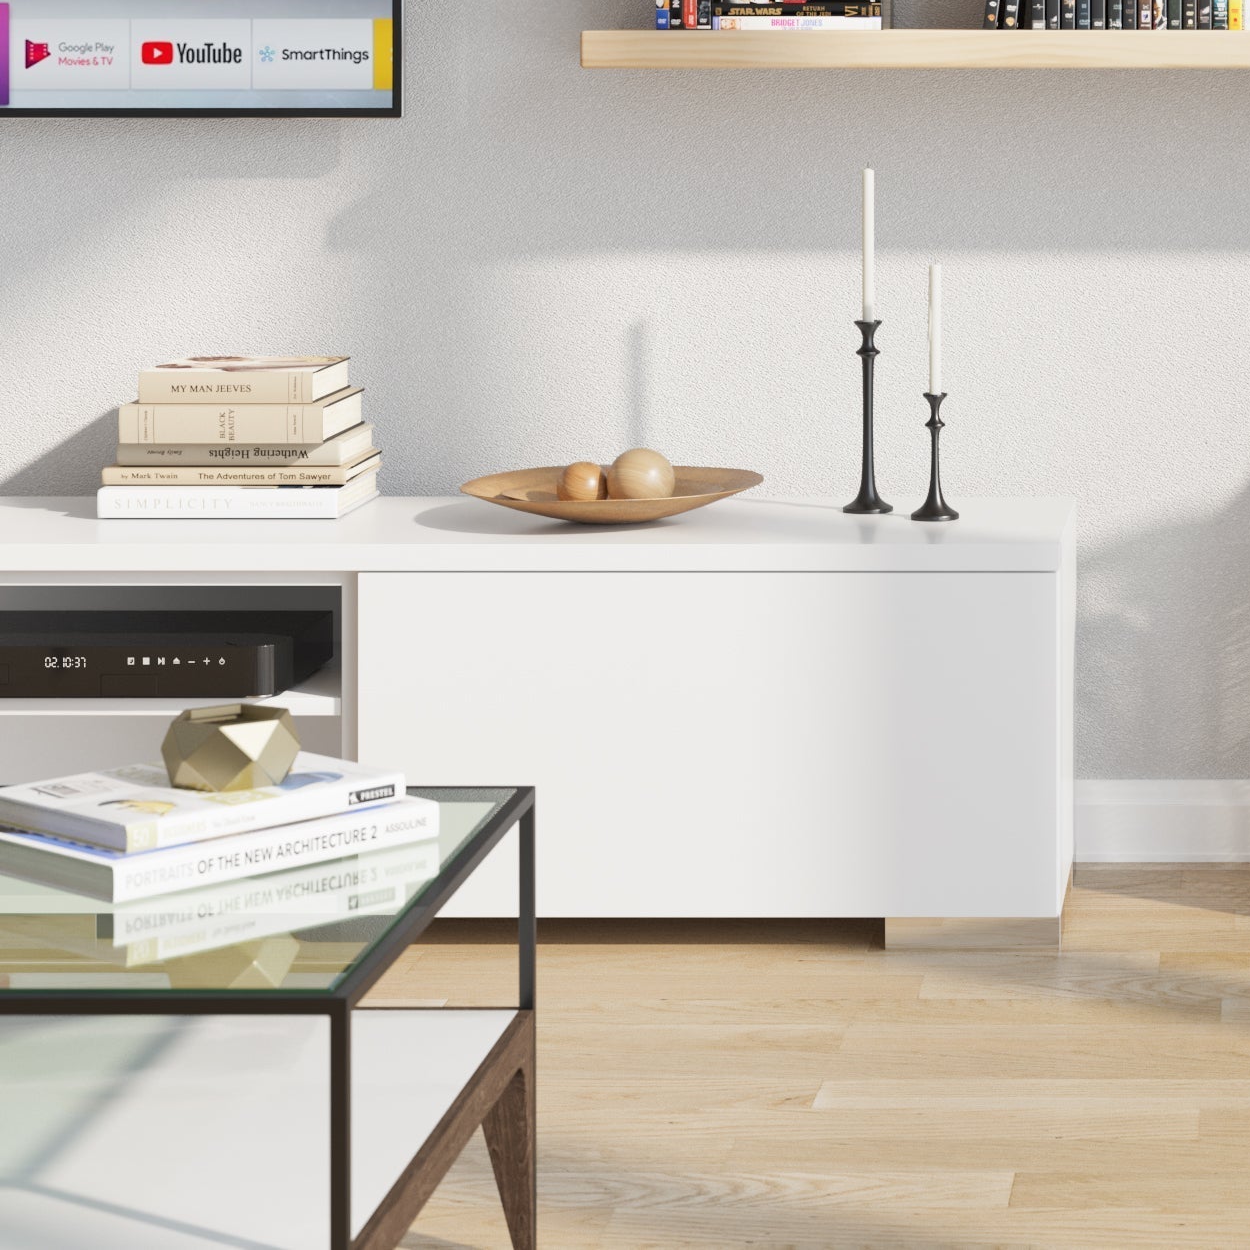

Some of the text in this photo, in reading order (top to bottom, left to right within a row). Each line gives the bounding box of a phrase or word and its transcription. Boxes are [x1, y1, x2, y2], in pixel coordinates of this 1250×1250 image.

[58, 43, 114, 54] Google Play
[178, 43, 242, 64] YouTube
[58, 57, 113, 66] Movies & TV
[282, 49, 369, 63] SmartThings
[171, 385, 252, 393] MY MAN JEEVES
[209, 448, 308, 459] Wuthering Heights
[199, 473, 331, 481] The Adventures of Tom Sawyer
[114, 498, 233, 510] SIMPLICITY
[385, 817, 427, 833] ASSOULINE
[126, 826, 377, 889] PORTRAITS OF THE NEW ARCHITECTURE 2
